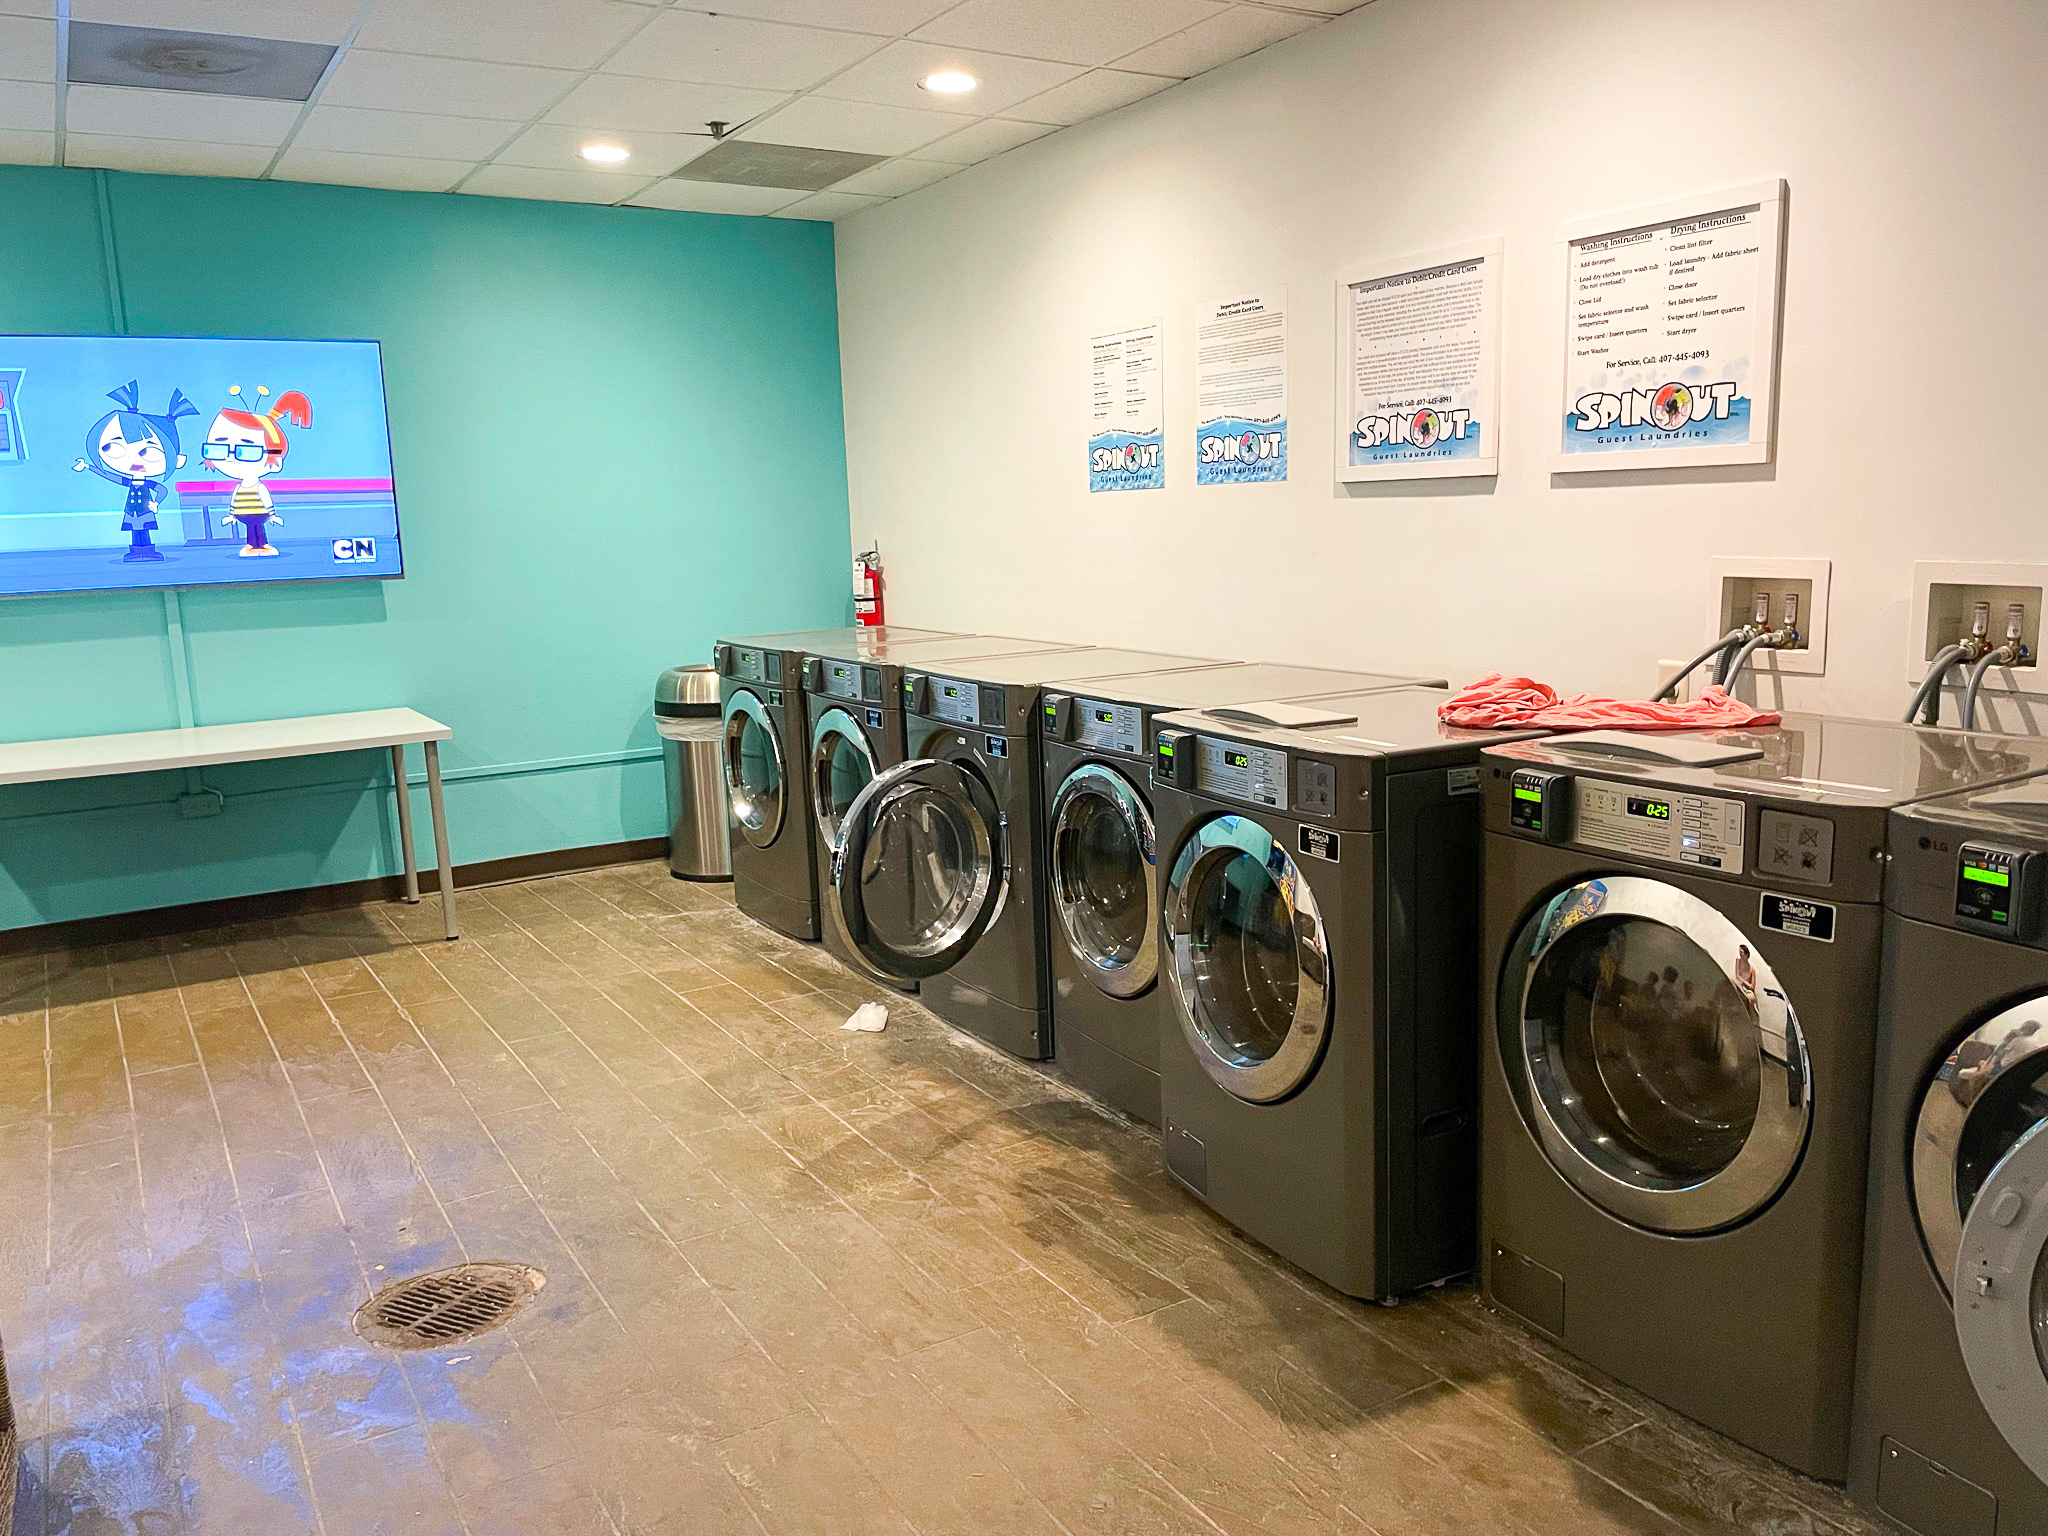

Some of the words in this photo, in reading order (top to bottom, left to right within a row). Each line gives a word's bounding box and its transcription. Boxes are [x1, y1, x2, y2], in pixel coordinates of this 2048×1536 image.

[1671, 224, 1696, 235] Drying
[1698, 215, 1746, 229] Instructions
[1580, 242, 1608, 251] Washing
[1610, 233, 1652, 246] Instructions
[1675, 266, 1694, 274] desired
[1360, 283, 1386, 293] Important
[1387, 280, 1404, 288] Notice
[1721, 306, 1745, 314] quarters
[1618, 357, 1641, 367] Service,
[1659, 350, 1709, 363] 407-445-4093
[1575, 382, 1736, 431] SPINOUT
[1357, 408, 1470, 449] SPINOUT
[1598, 435, 1633, 444] Guest
[1641, 431, 1708, 441] Laundries
[1201, 431, 1282, 465] SPINOUT
[1404, 450, 1452, 458] Laundries
[1092, 443, 1159, 474] SPINOUT
[334, 540, 374, 558] CN
[1934, 842, 1949, 852] LG
